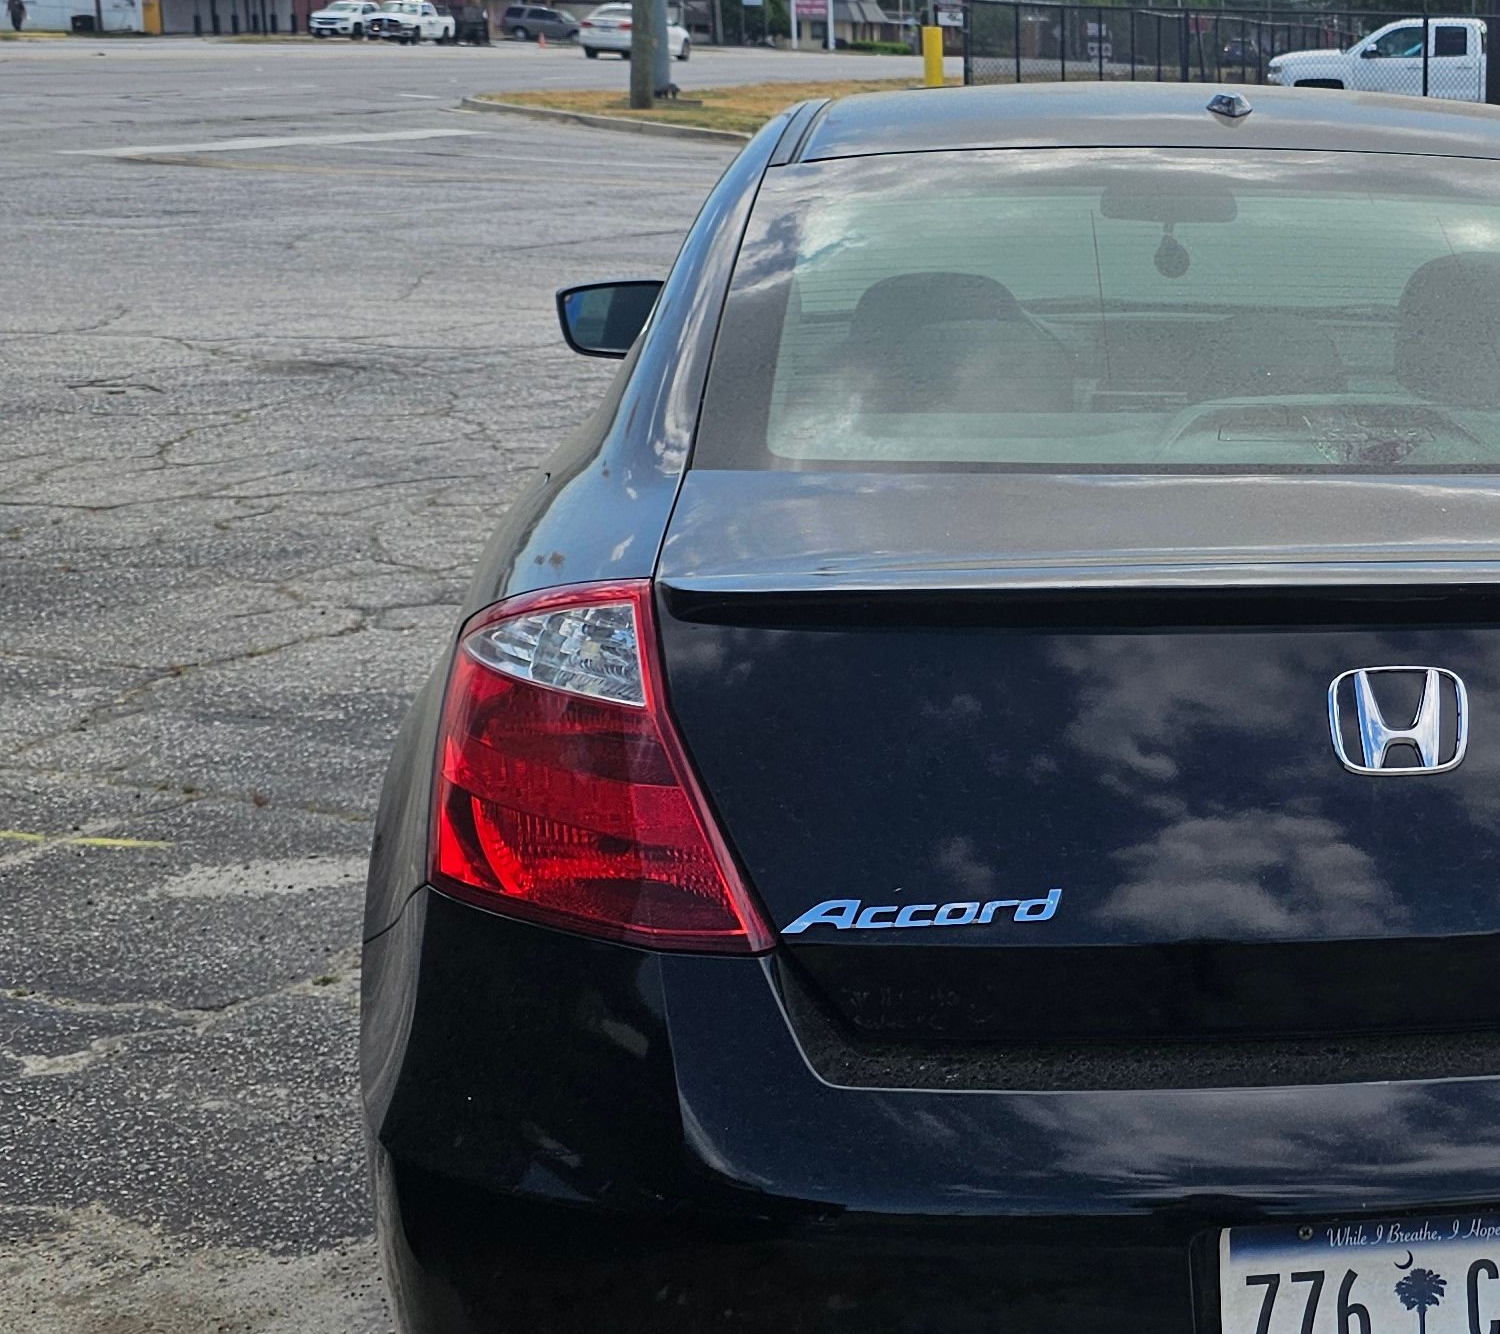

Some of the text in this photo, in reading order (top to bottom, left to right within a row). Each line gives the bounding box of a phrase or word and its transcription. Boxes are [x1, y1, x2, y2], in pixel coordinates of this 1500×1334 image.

[780, 889, 1062, 934] Accord
[1326, 1224, 1368, 1248] While
[1370, 1224, 1384, 1245] I
[1386, 1220, 1442, 1244] Breathe,
[1446, 1219, 1460, 1240] I
